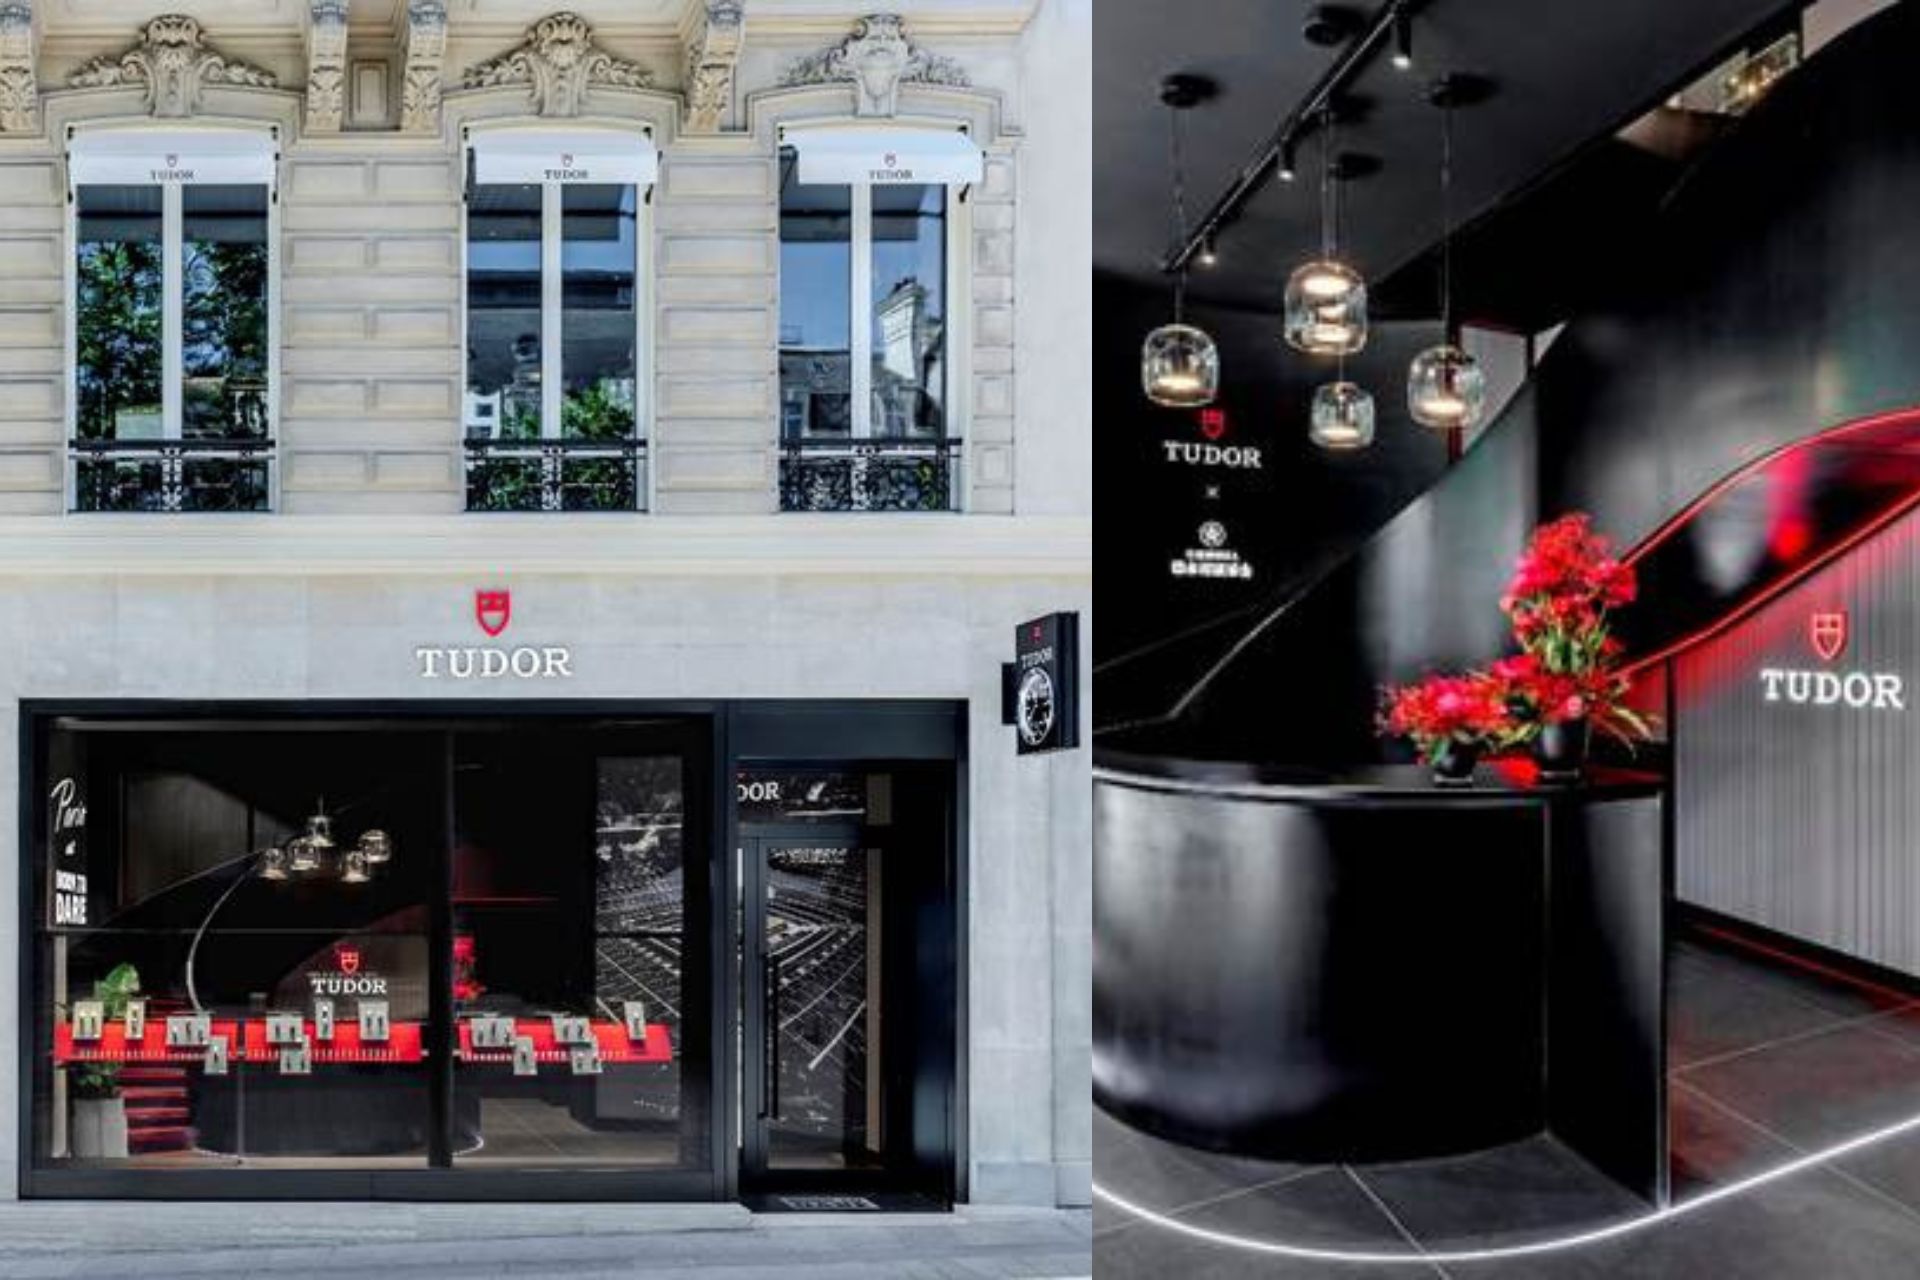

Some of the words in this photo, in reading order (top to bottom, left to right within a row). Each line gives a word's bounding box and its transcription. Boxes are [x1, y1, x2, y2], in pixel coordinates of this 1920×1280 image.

[543, 169, 588, 180] TUDOR
[1162, 440, 1262, 468] TUDOR
[416, 647, 572, 678] TUDOR
[1760, 667, 1904, 709] TUDOR
[310, 977, 387, 995] TUDOR
